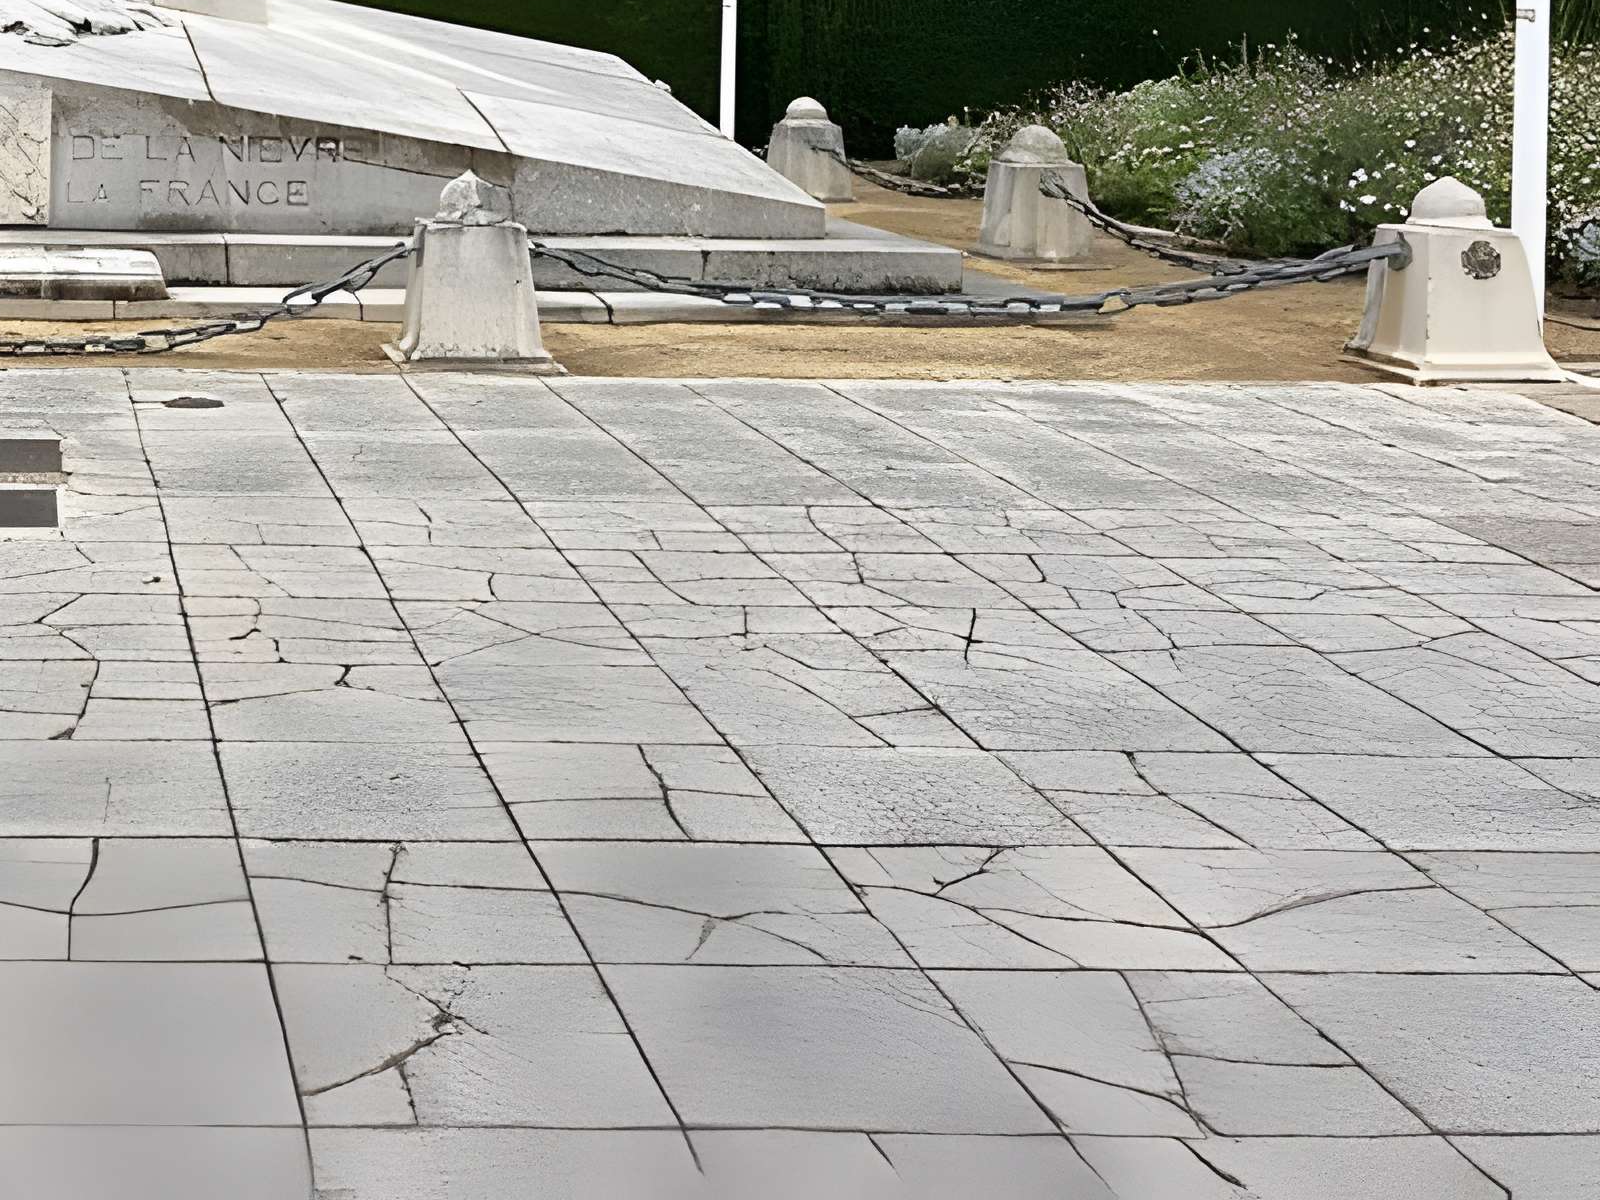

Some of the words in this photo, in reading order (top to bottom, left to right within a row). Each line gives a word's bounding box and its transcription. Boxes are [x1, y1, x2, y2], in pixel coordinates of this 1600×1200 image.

[71, 135, 123, 160] DE
[145, 135, 196, 163] LA
[66, 179, 110, 204] LA
[140, 179, 310, 206] FRANCE
